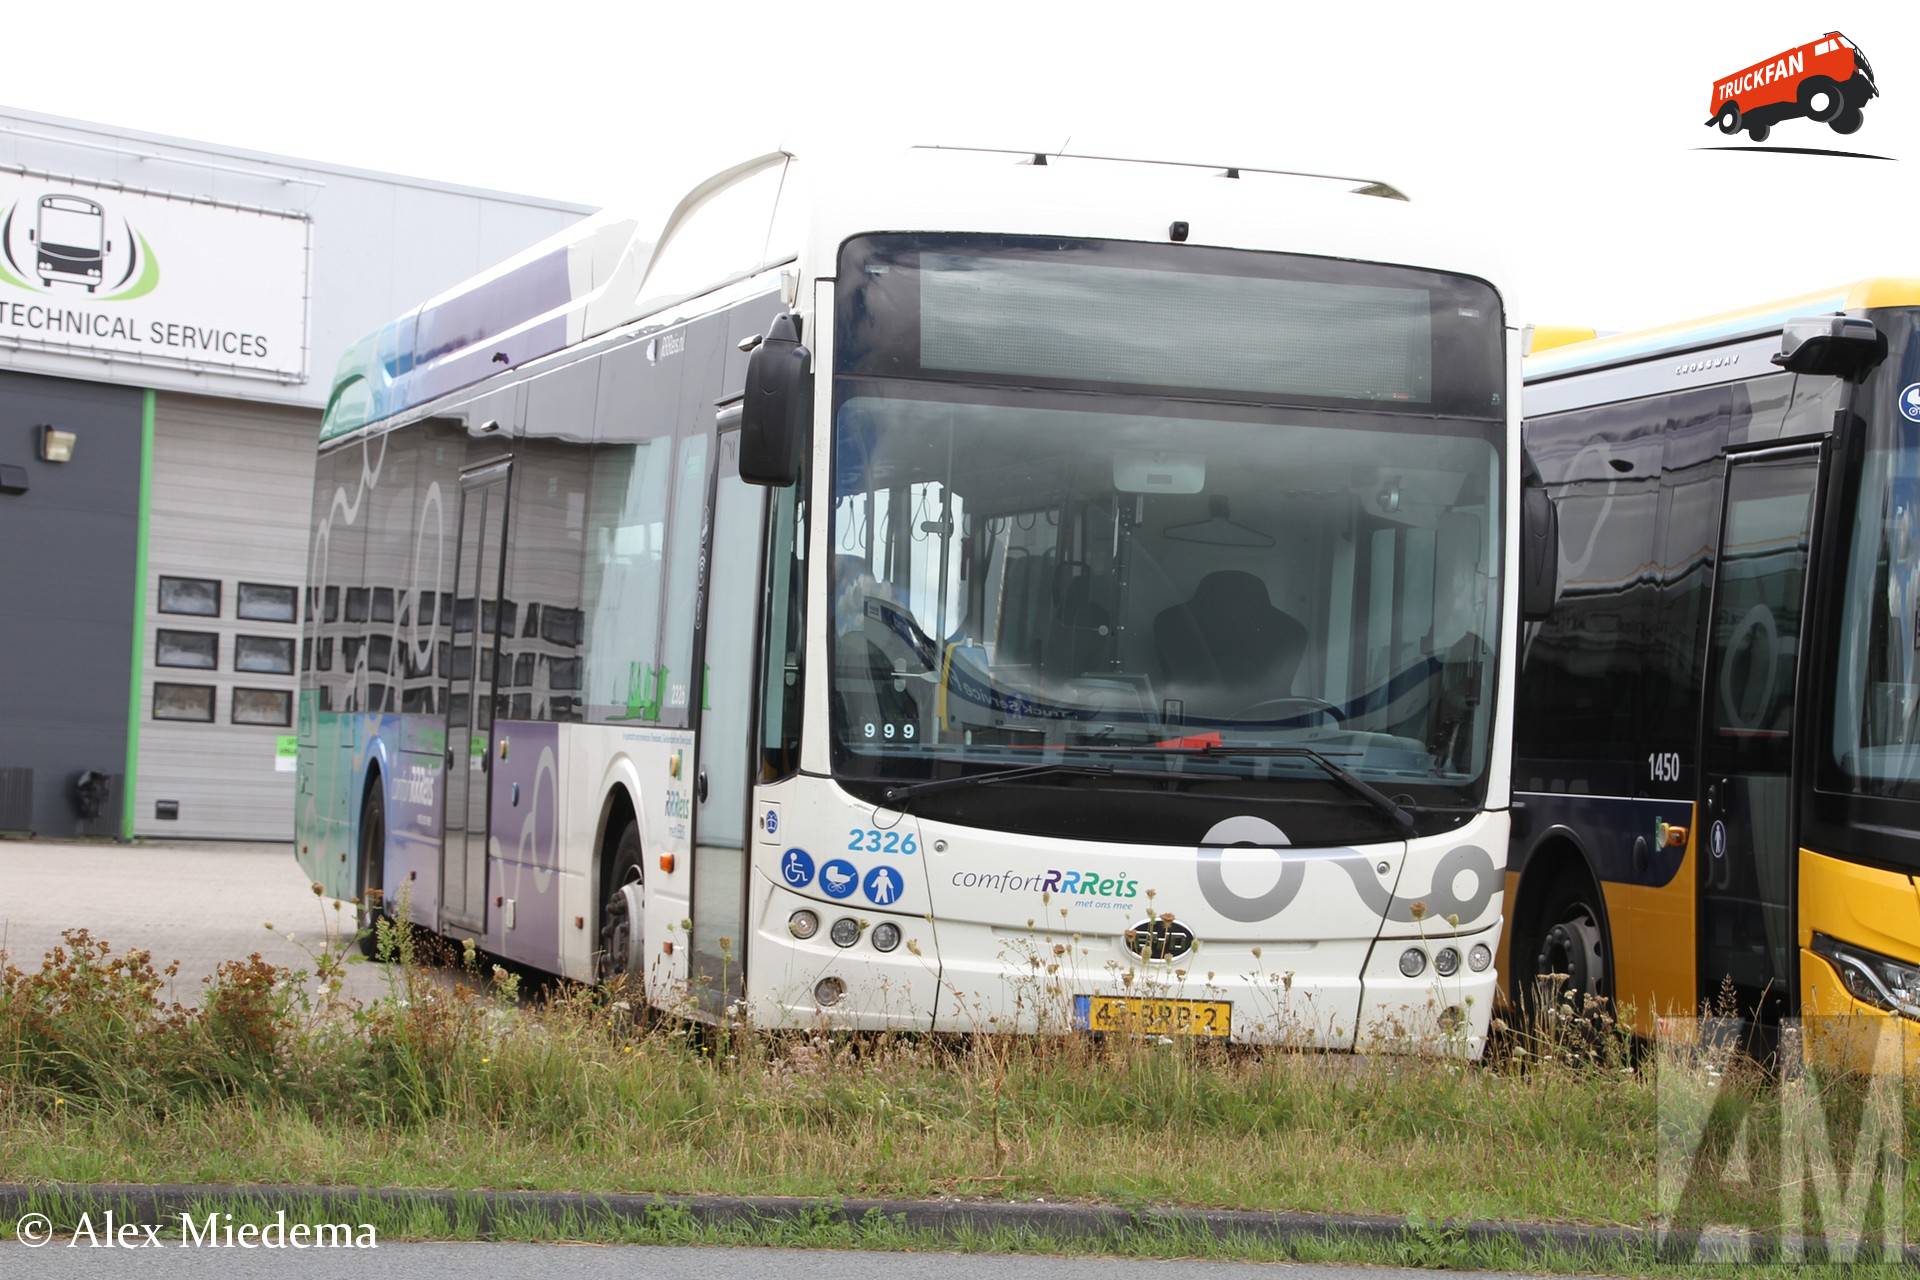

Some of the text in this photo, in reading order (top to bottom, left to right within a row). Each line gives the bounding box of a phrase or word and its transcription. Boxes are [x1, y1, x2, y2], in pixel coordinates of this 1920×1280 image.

[150, 321, 268, 358] SERVICES
[1648, 752, 1680, 782] 1450
[848, 828, 917, 855] 2326
[952, 870, 1139, 898] comfortRRReis
[1074, 899, 1134, 912] met ons mee
